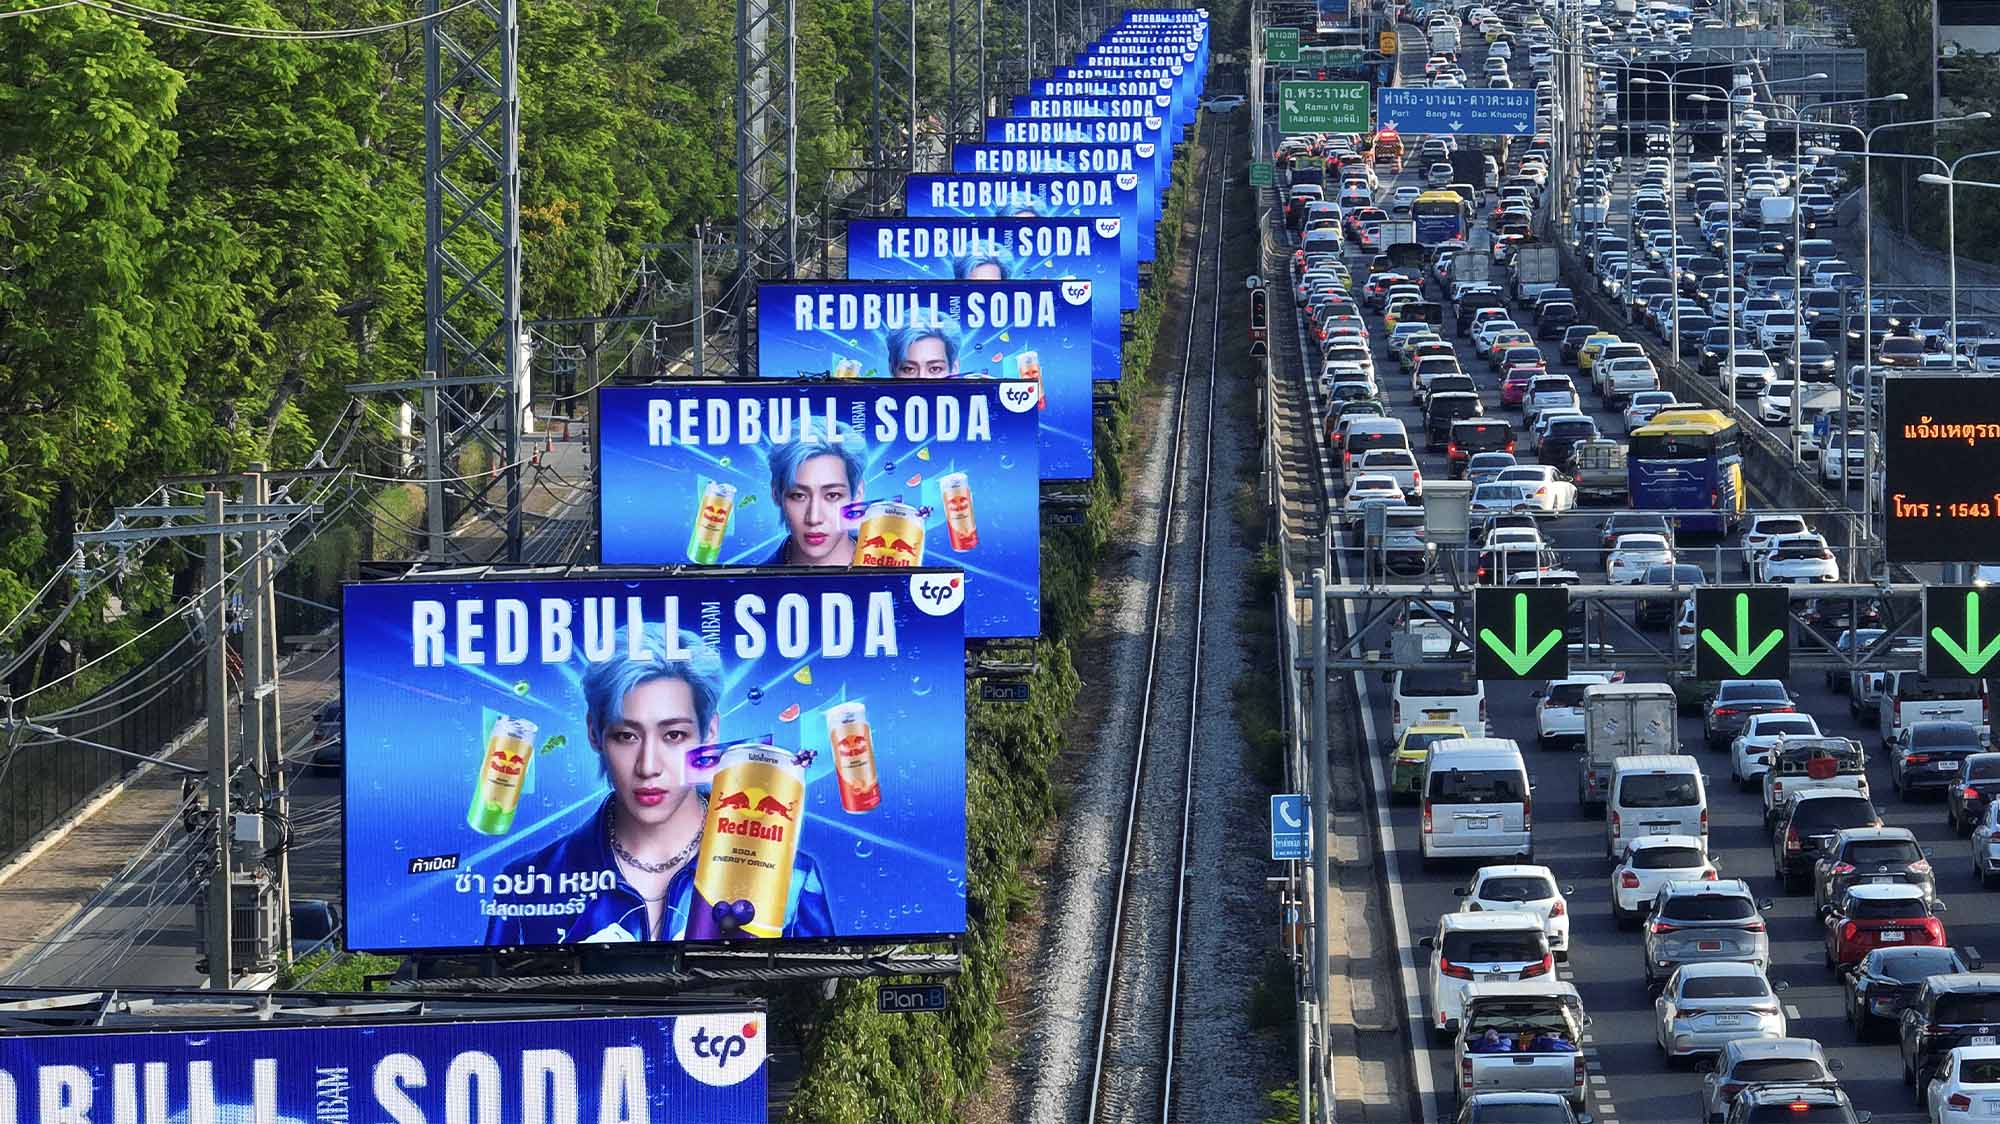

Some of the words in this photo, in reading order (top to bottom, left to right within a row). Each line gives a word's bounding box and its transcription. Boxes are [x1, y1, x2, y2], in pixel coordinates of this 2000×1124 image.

[1031, 100, 1100, 117] REDBULL
[1112, 100, 1153, 117] SODA
[1304, 103, 1328, 111] Rama
[1331, 103, 1339, 111] IV
[1343, 103, 1354, 111] Rd
[1391, 110, 1409, 118] Port
[1426, 110, 1447, 119] Bang
[1490, 111, 1528, 120] Khanong
[1005, 122, 1082, 143] REDBULL
[1096, 122, 1143, 142] SODA
[975, 150, 1063, 172] REDBULL
[1079, 150, 1133, 171] SODA
[932, 181, 1036, 208] REDBULL
[1051, 181, 1113, 207] SODA
[1100, 221, 1116, 233] tcp
[878, 227, 1000, 258] REDBULL
[1019, 227, 1091, 257] SODA
[1067, 283, 1087, 299] tcp
[794, 292, 945, 331] REDBULL
[968, 291, 1056, 328] SODA
[1005, 387, 1031, 404] tcp
[649, 397, 846, 446] REDBULL
[875, 395, 991, 443] SODA
[1893, 494, 1929, 518] โทร
[1949, 503, 1990, 517] 1543
[918, 579, 953, 602] tcp
[413, 596, 690, 667] REDBULL
[735, 592, 899, 660] SODA
[984, 686, 1014, 699] Plan
[712, 855, 746, 867] ENERGY
[747, 858, 777, 869] DRINK
[731, 847, 757, 857] SODA
[493, 865, 551, 895] อย่า
[559, 869, 617, 900] หยุด
[882, 990, 924, 1009] Plan
[689, 1027, 748, 1068] tcp
[0, 1058, 278, 1124] BULL
[372, 1046, 651, 1124] SODA
